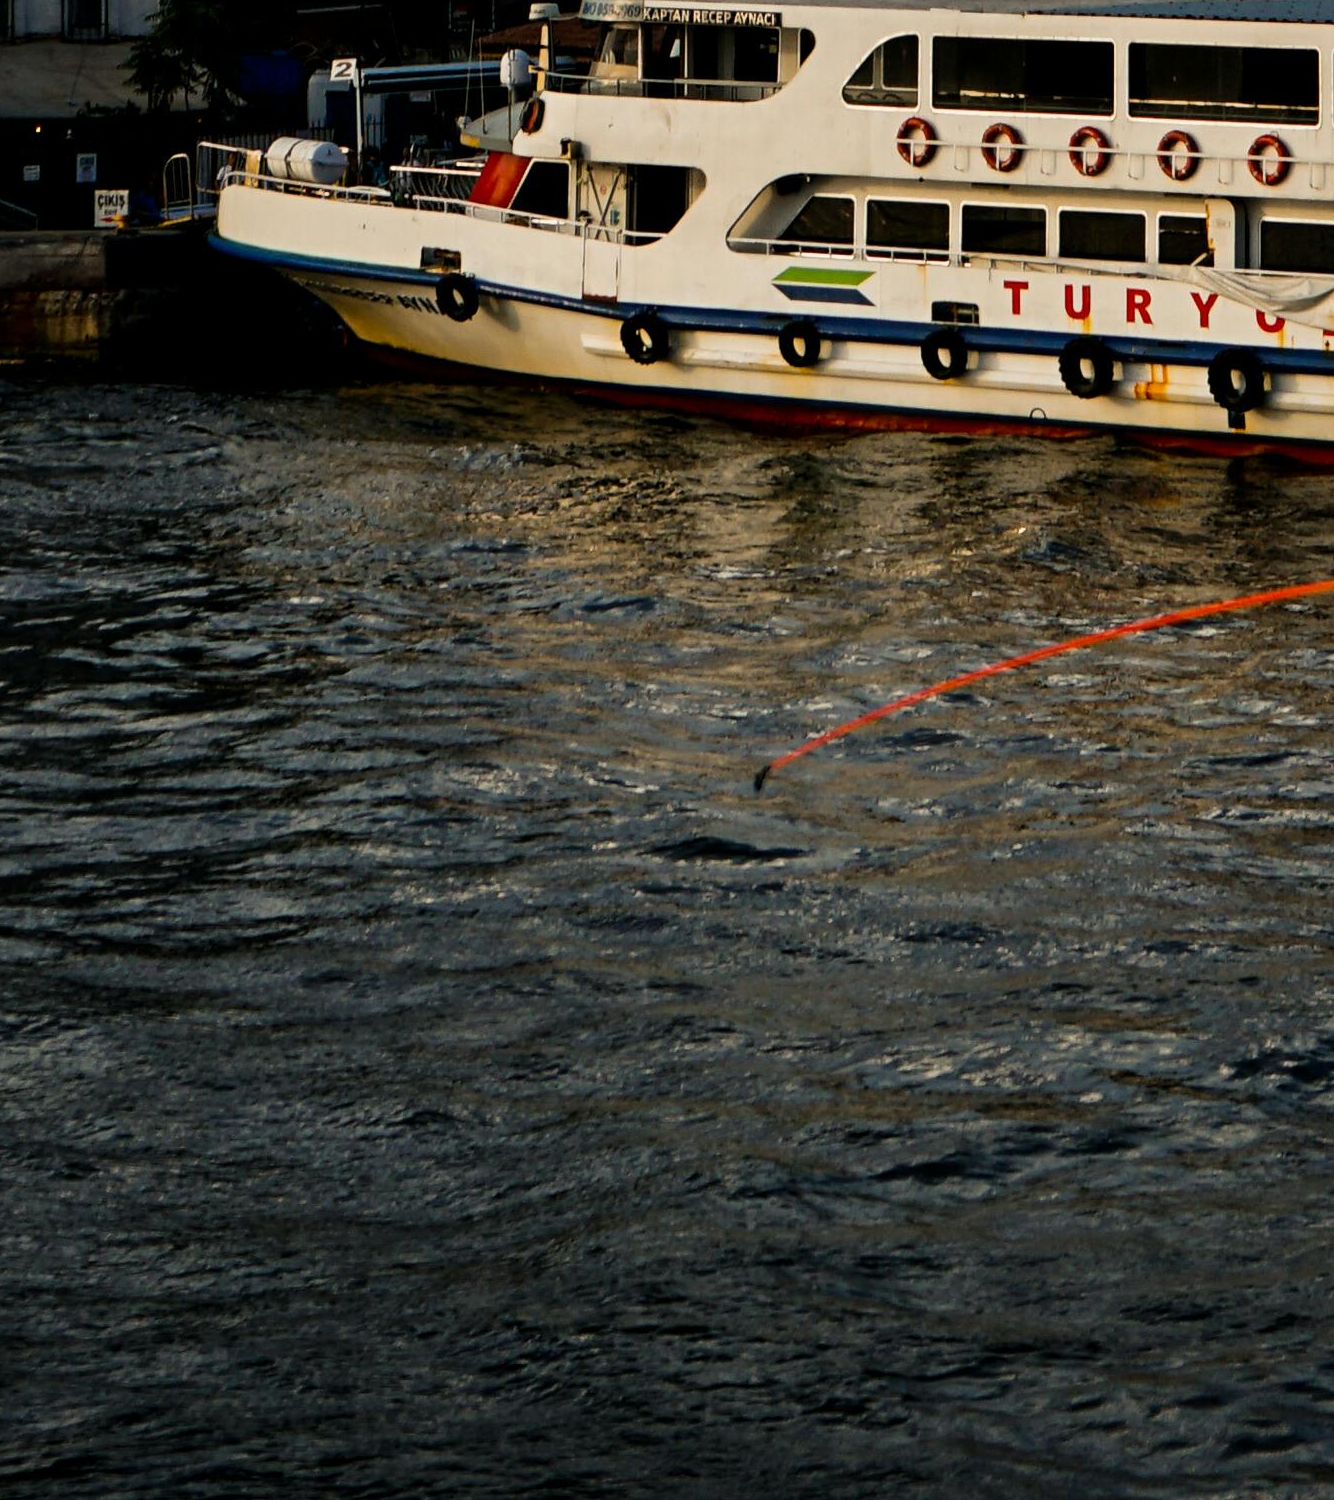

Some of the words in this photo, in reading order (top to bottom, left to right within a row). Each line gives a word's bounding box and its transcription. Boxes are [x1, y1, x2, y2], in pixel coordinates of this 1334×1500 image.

[643, 8, 690, 23] KAPTAN
[692, 10, 732, 25] RECEP
[734, 11, 776, 26] AYNACI
[334, 62, 352, 78] 2
[97, 194, 126, 209] ÇIKIŞ
